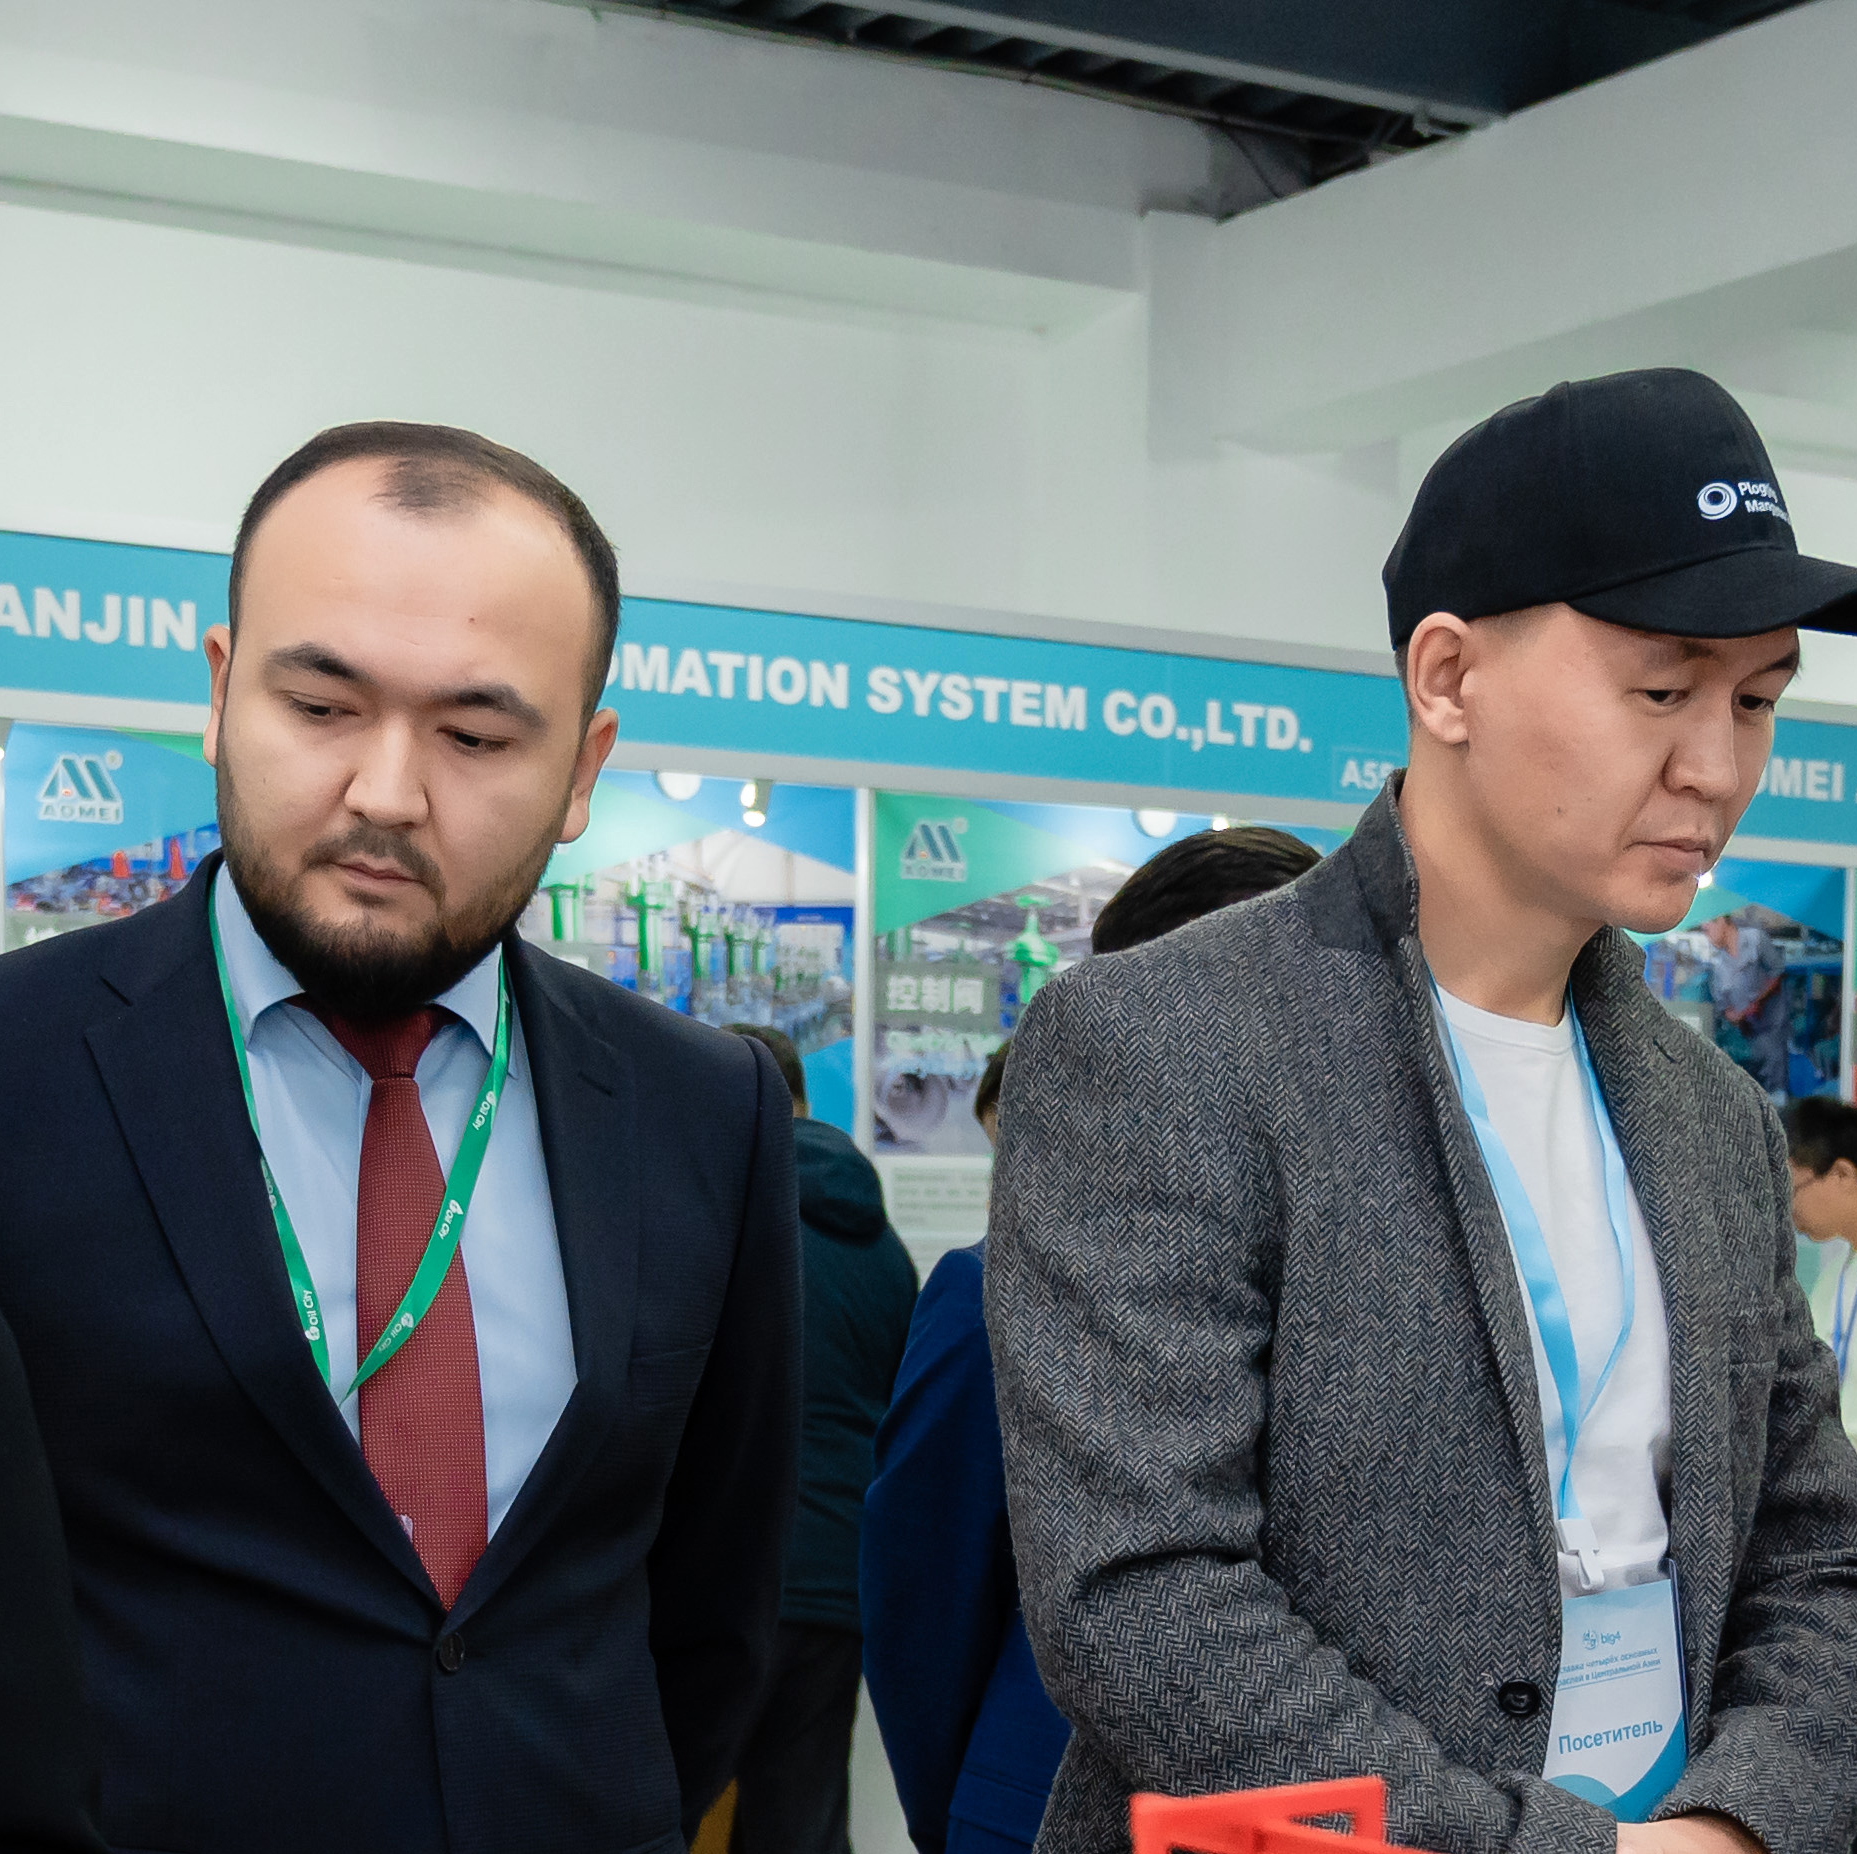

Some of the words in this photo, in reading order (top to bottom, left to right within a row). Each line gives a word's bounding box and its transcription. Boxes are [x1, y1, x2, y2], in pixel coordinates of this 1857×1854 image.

[867, 666, 1087, 731] SYSTEM
[43, 804, 121, 822] AOMEI
[1559, 1720, 1663, 1754] Посетитель
